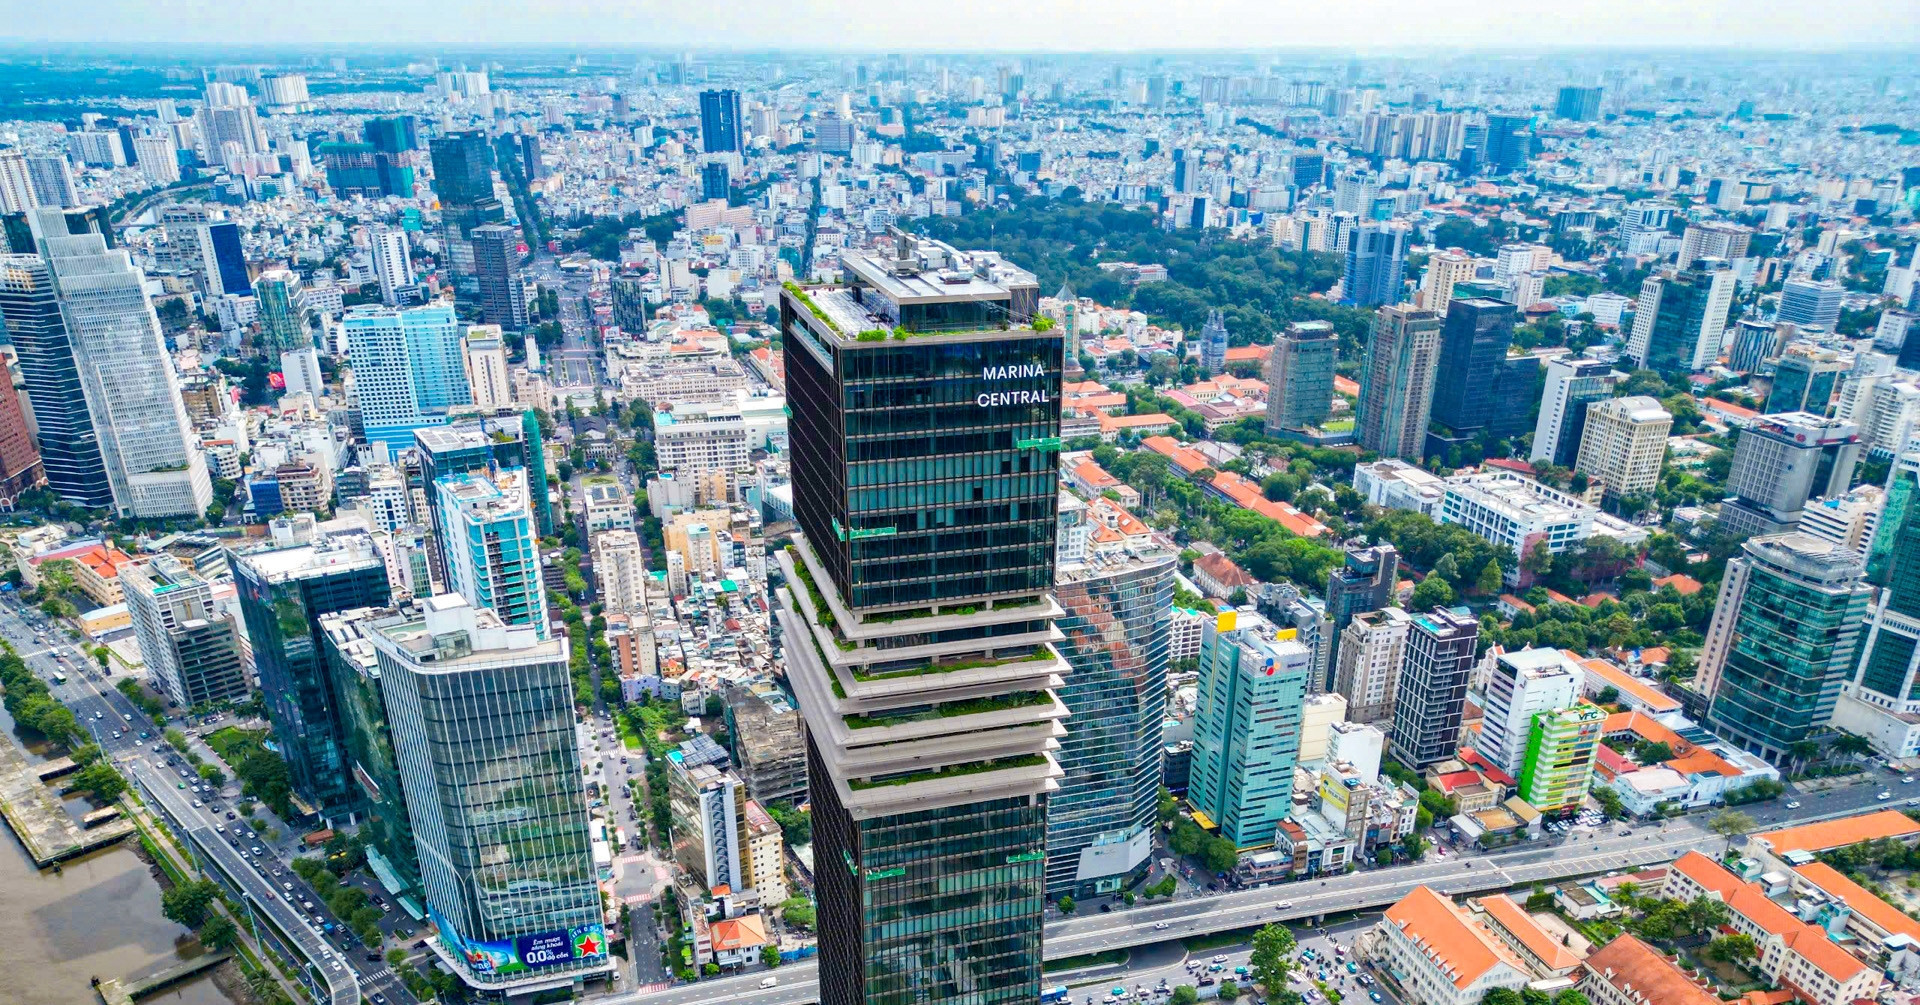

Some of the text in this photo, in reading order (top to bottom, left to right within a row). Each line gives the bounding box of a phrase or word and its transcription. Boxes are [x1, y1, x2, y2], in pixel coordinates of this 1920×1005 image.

[983, 363, 1044, 380] MARINA
[977, 389, 1050, 407] CENTRAL
[1578, 711, 1598, 720] VFC
